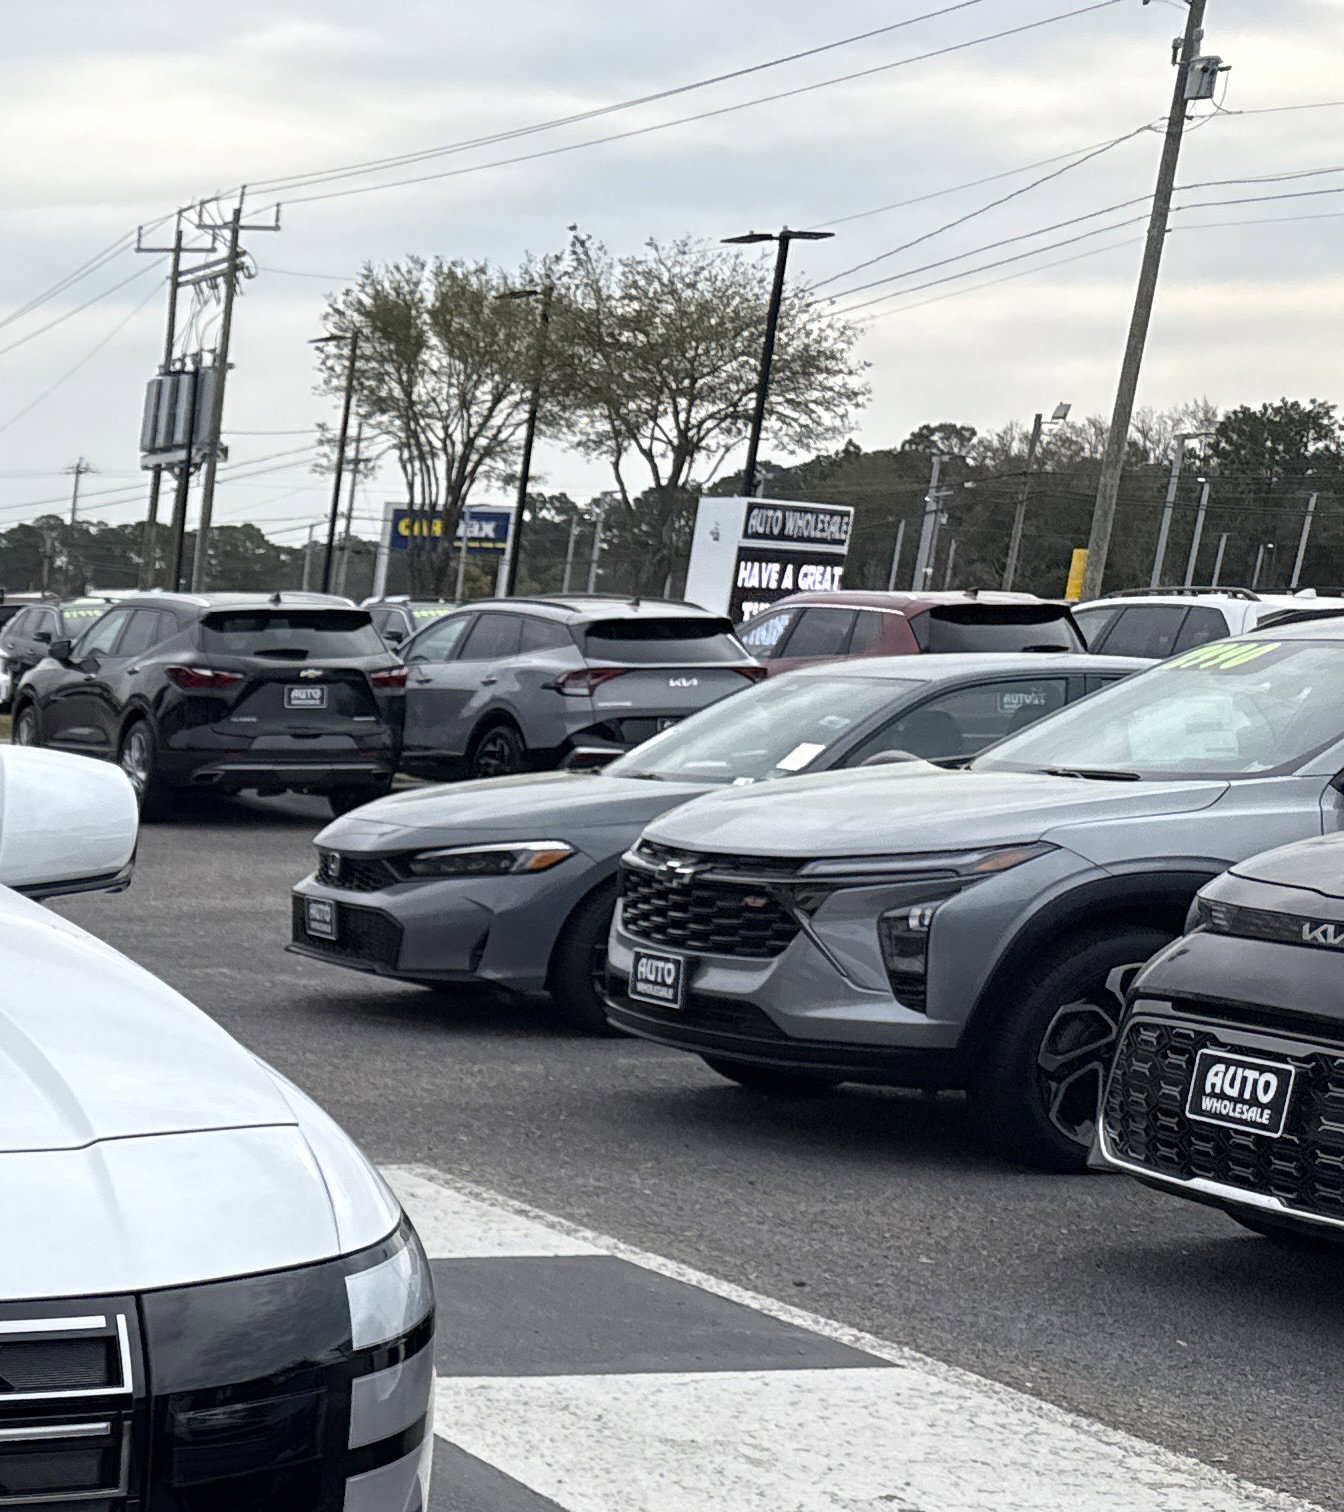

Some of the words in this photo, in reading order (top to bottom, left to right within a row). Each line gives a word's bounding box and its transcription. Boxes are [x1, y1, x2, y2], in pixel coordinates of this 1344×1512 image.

[748, 508, 783, 535] AUTO
[784, 511, 849, 541] WHOLESALE
[737, 561, 781, 590] HAVE
[781, 564, 794, 590] A
[798, 565, 844, 592] GREAT
[290, 688, 322, 699] AUTO
[638, 958, 675, 985] AUTO
[1205, 1063, 1278, 1104] AUTO
[1202, 1096, 1272, 1125] WHOLESALE
